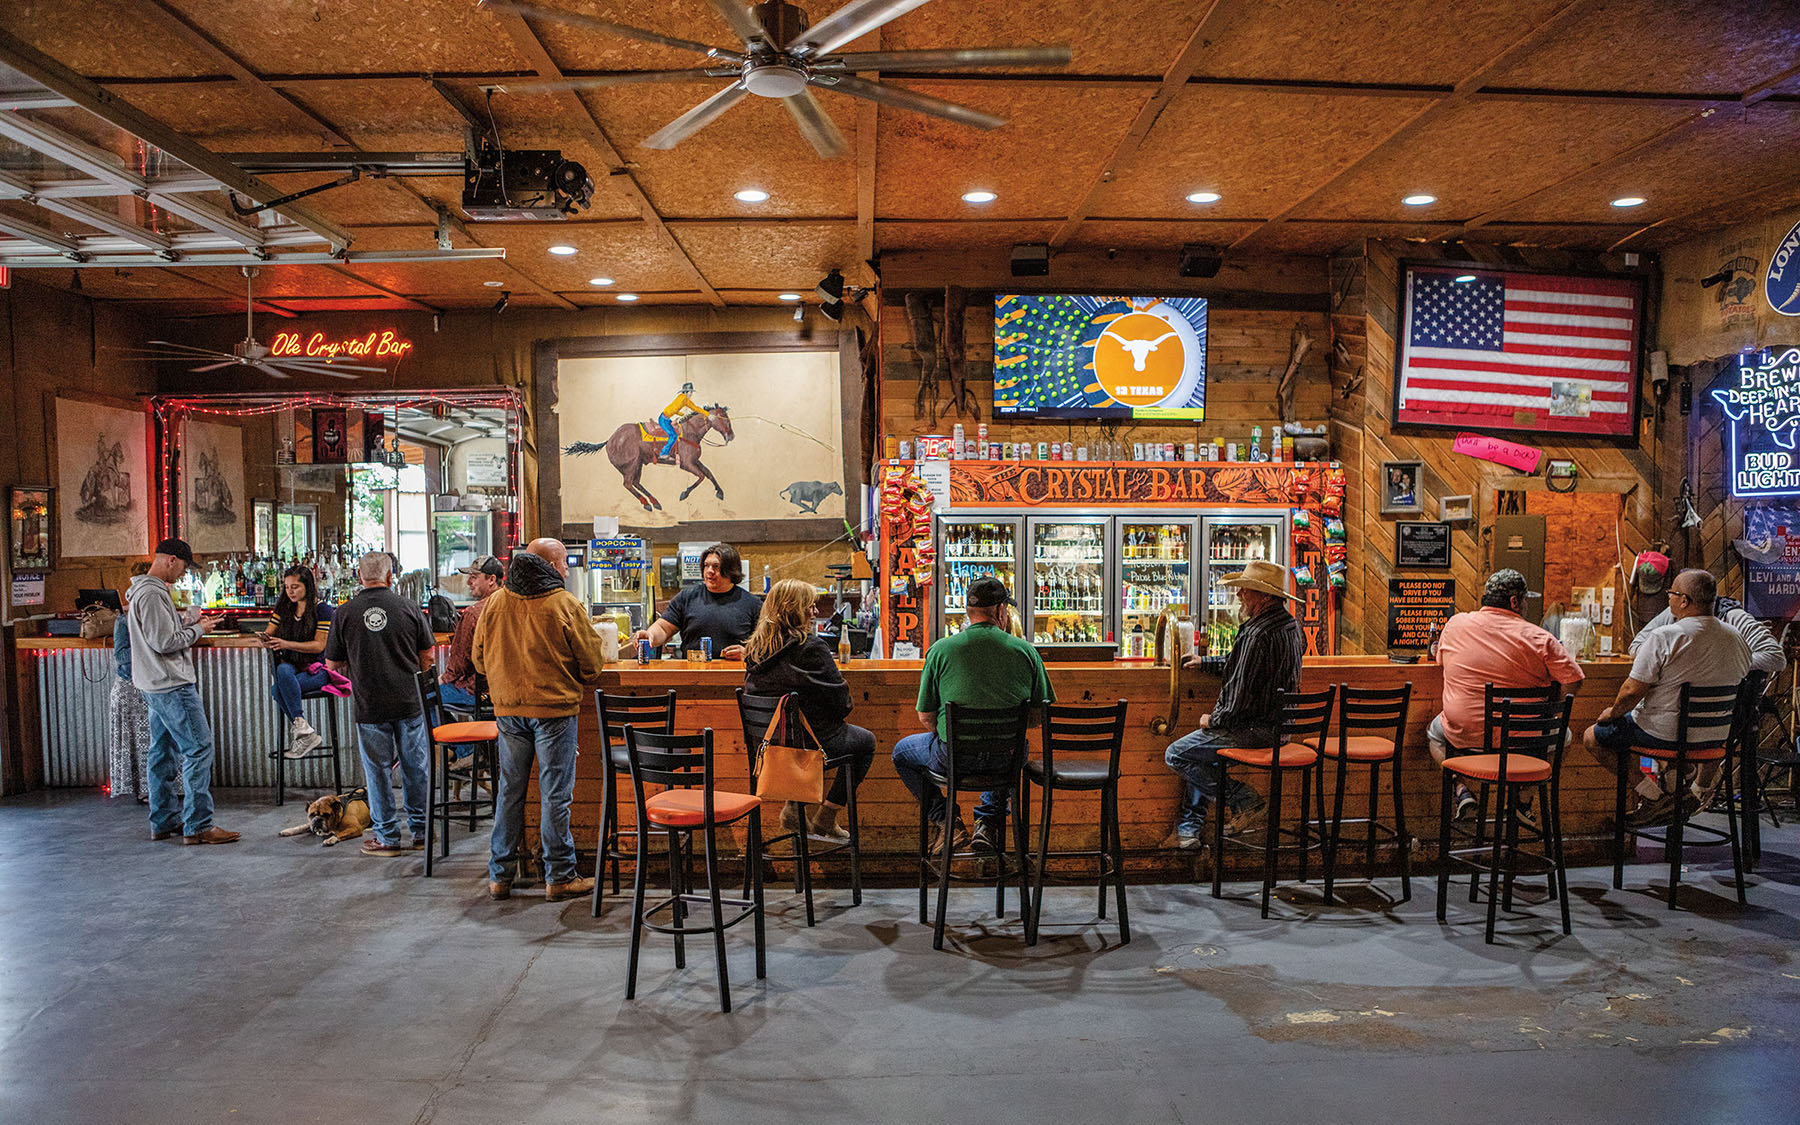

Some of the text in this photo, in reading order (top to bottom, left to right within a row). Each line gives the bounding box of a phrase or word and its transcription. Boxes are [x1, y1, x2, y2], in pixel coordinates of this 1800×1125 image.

[272, 331, 411, 363] Ole Crystal Bar
[1740, 365, 1800, 391] BREW
[1129, 386, 1164, 396] TEXAS
[1728, 389, 1768, 405] DEEP
[1773, 385, 1790, 400] IN
[1488, 441, 1499, 450] be
[1745, 452, 1791, 471] BUD
[993, 466, 1207, 505] THE CRYSTAL BAR
[1738, 469, 1800, 489] LIGHT
[951, 561, 995, 580] Happy
[1131, 571, 1151, 582] Pabst
[1750, 572, 1773, 583] LEVI
[1776, 574, 1792, 582] AND
[1399, 638, 1419, 646] NIGHT,
